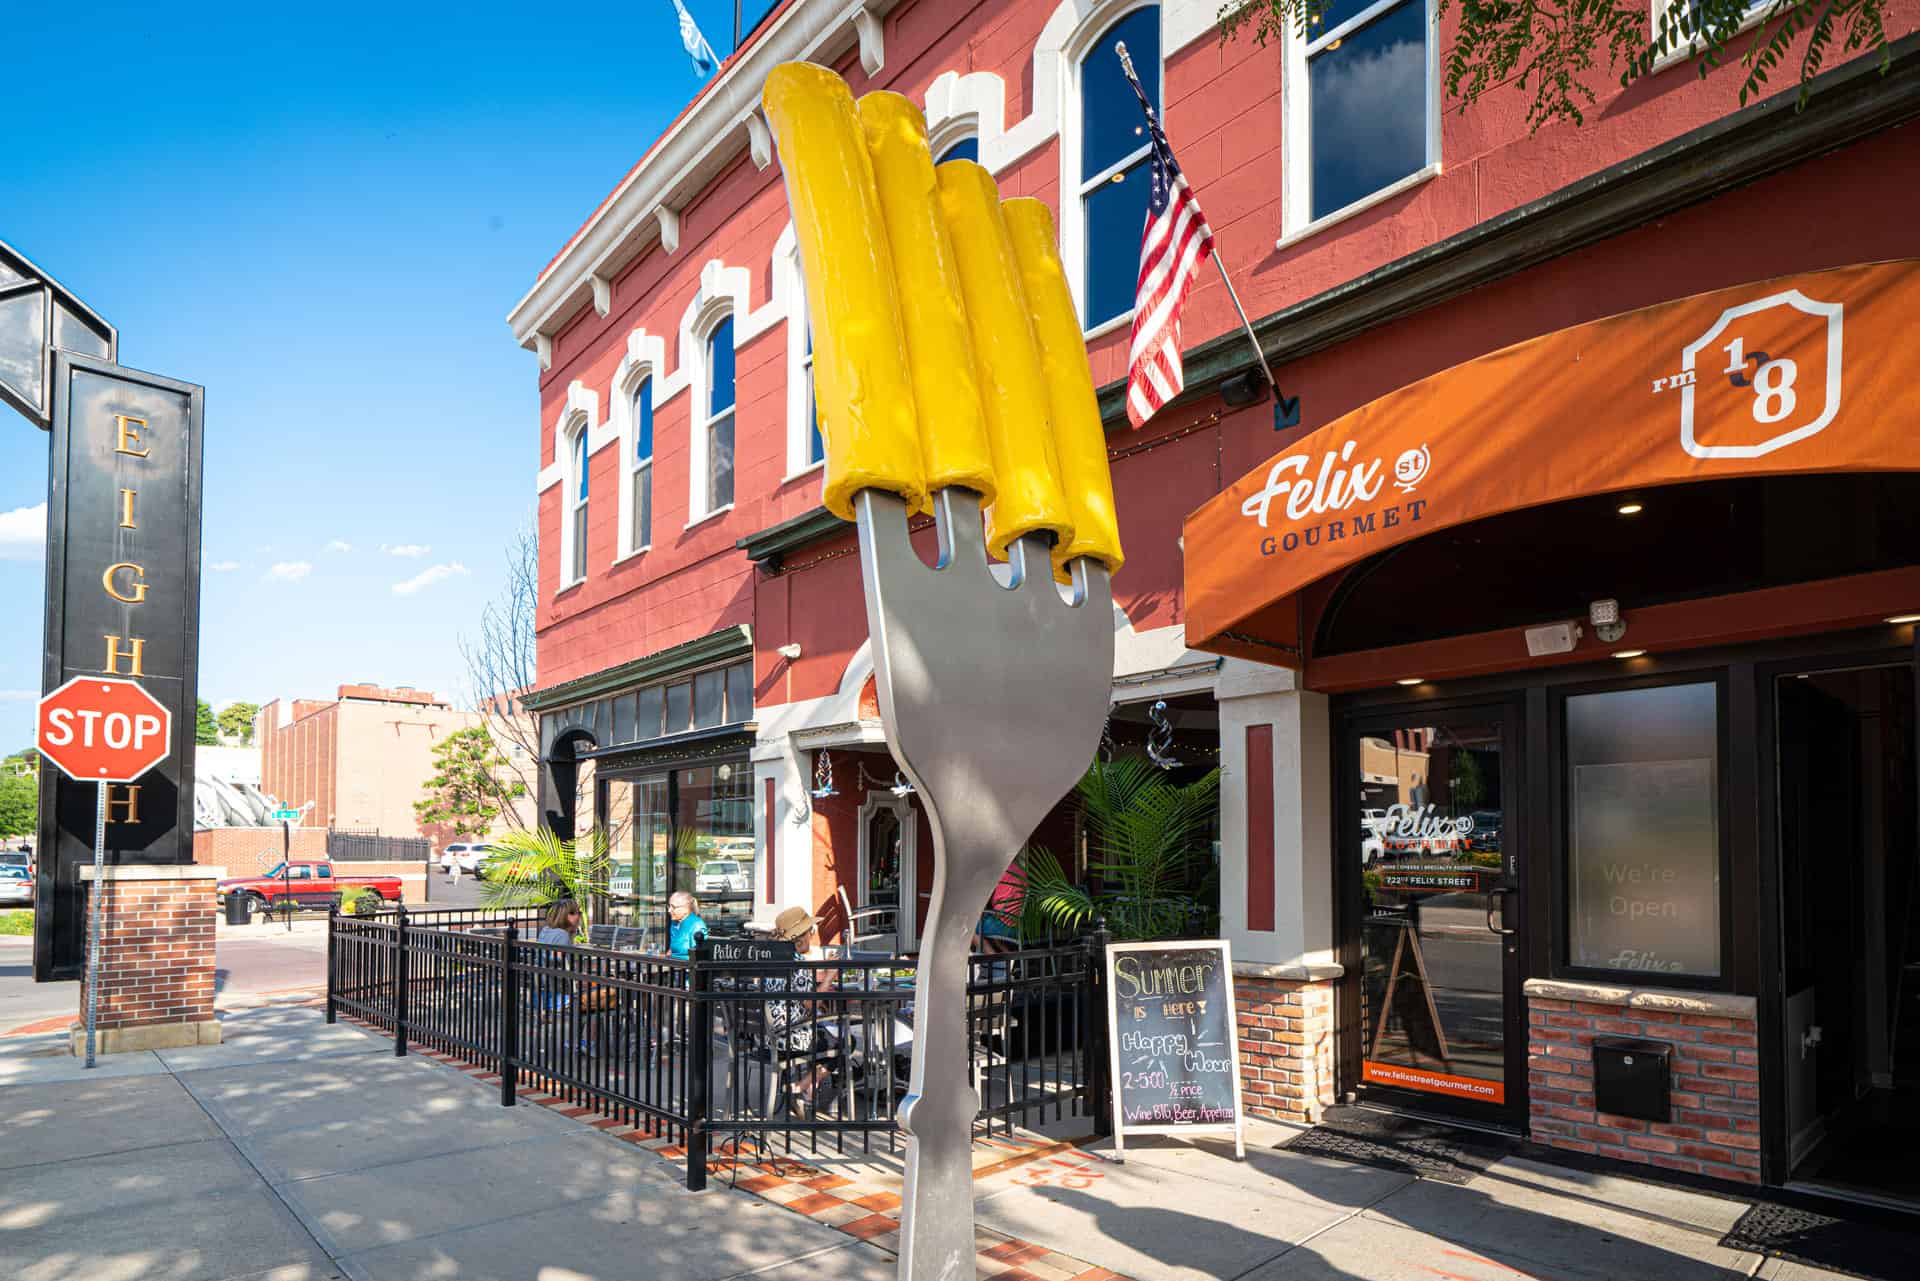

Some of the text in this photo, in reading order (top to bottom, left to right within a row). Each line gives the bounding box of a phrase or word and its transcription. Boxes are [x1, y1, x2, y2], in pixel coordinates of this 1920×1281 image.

[1652, 336, 1797, 423] rm 18
[1241, 440, 1385, 528] Felix
[1260, 500, 1427, 556] GOURMET
[102, 414, 151, 825] EIGHH
[45, 707, 161, 750] STOP
[1383, 803, 1449, 838] Felix
[1410, 876, 1434, 886] FELIX
[1438, 877, 1472, 887] STREET
[1603, 863, 1677, 884] We're
[1609, 895, 1677, 920] Open
[713, 944, 741, 960] Patio
[1115, 956, 1213, 998] Summer
[1122, 1031, 1188, 1056] Happy
[1184, 1050, 1233, 1072] Hour
[1370, 1067, 1495, 1096] www.felixstreetgourmet.com
[1124, 1104, 1153, 1121] Wine
